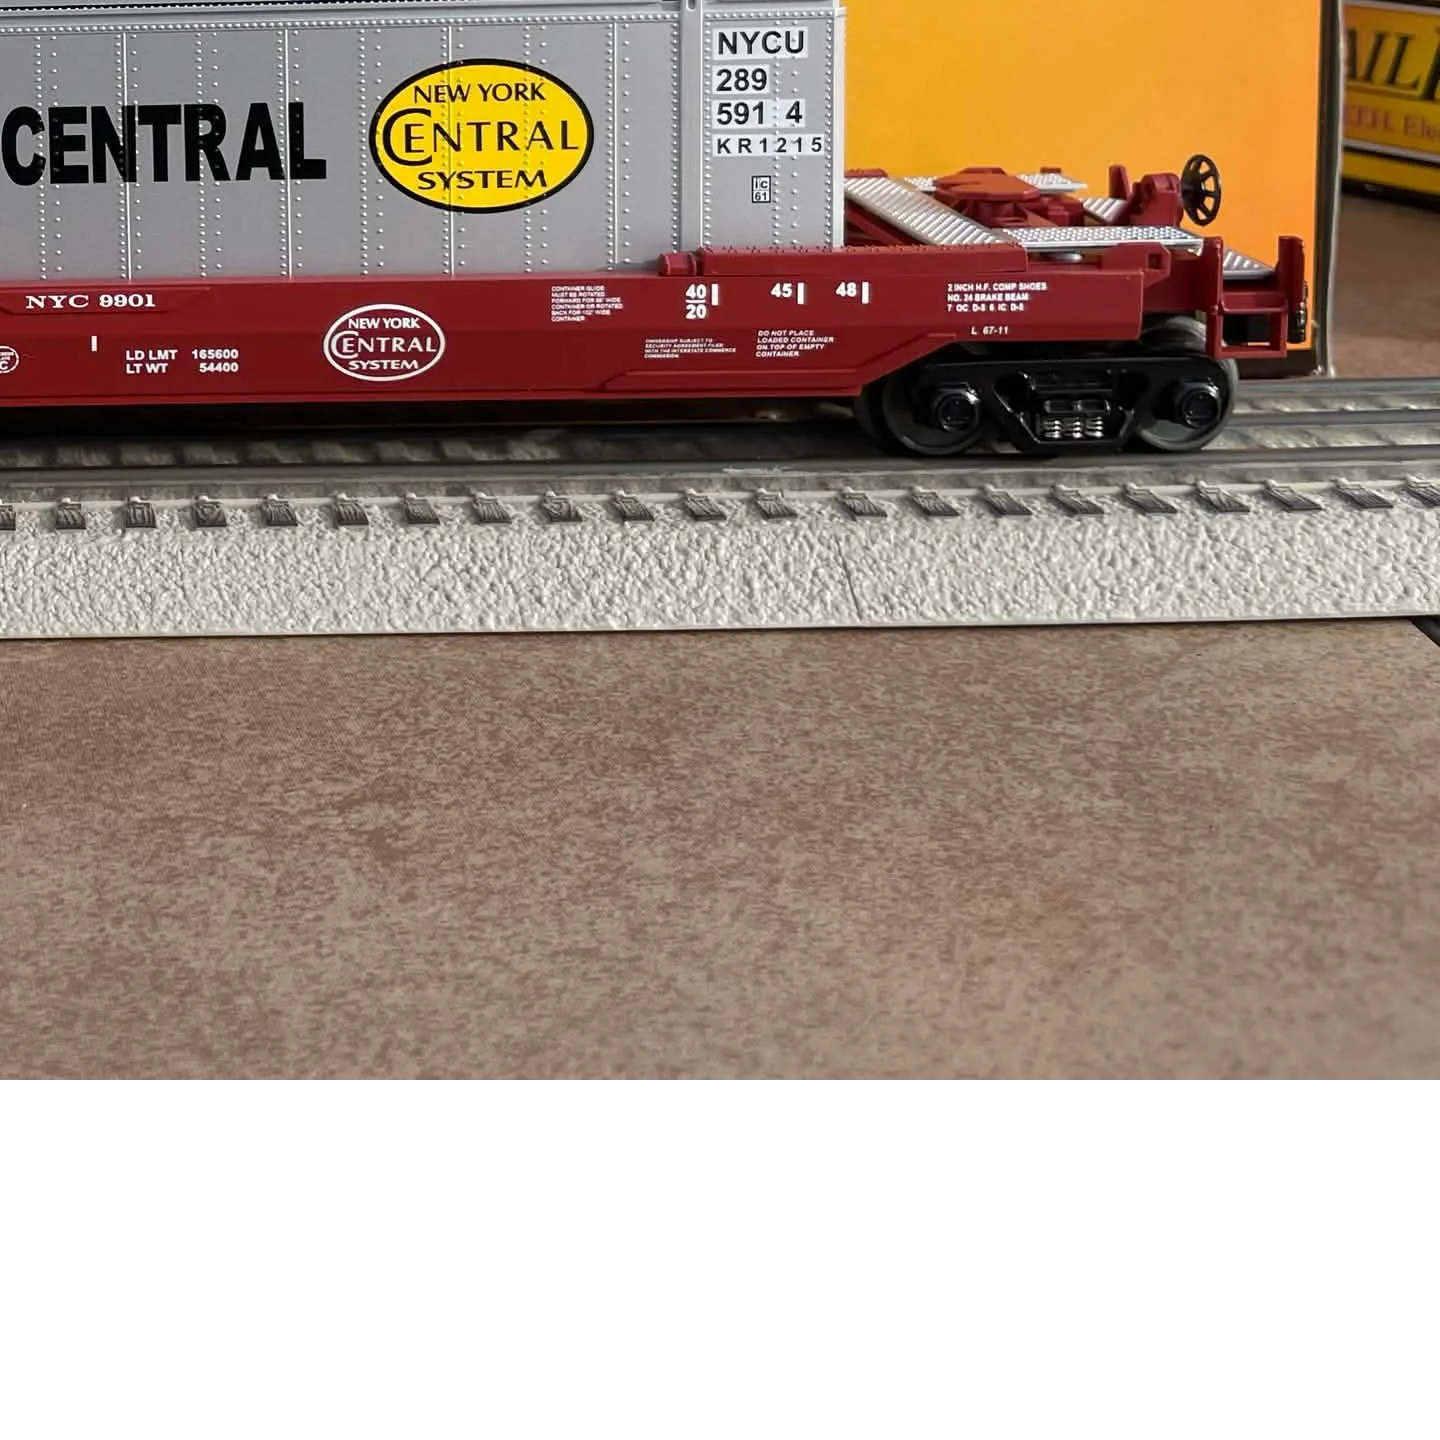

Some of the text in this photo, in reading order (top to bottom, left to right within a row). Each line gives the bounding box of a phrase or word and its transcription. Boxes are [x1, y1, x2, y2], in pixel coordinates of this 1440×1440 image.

[718, 31, 805, 55] NYCU
[716, 68, 768, 92] 289
[414, 82, 546, 104] NEW YORK
[716, 101, 803, 125] 591 4
[0, 101, 327, 188] CENTRAL
[382, 107, 579, 167] CENTRAL
[418, 169, 547, 191] SYSTEM
[754, 192, 768, 201] 61
[685, 284, 707, 299] 40
[770, 283, 793, 298] 45
[835, 282, 857, 297] 48
[954, 283, 974, 291] INCH
[993, 283, 1017, 291] COMP
[1019, 282, 1048, 291] SHOES
[25, 294, 156, 309] NYC 9901
[964, 294, 973, 302] 24
[975, 293, 1004, 301] BRAKE
[1005, 292, 1029, 301] BEAM
[685, 304, 707, 319] 20
[956, 304, 969, 312] OC
[998, 303, 1006, 311] IC
[348, 317, 421, 329] NEW YORK
[971, 326, 1009, 335] L 67-11
[330, 330, 437, 359] CENTRAL
[126, 349, 239, 361] LD LMT 165600
[126, 362, 239, 374] LT WT 54400
[348, 360, 419, 371] SYSTEM
